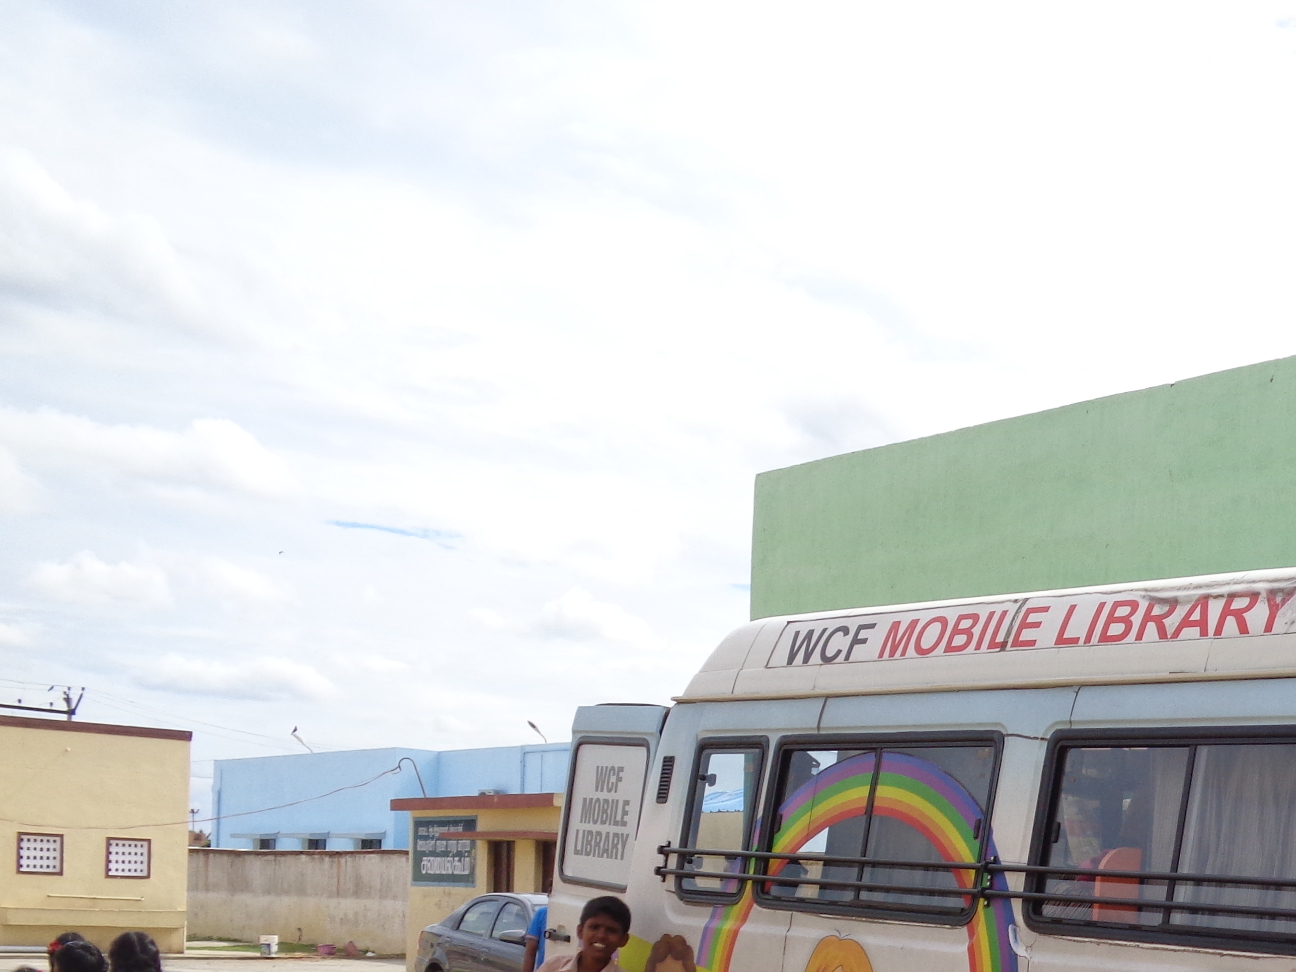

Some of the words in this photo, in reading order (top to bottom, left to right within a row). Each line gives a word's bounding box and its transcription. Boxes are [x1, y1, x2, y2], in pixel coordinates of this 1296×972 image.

[786, 623, 877, 665] WCF
[877, 606, 1050, 659] MOBILE
[595, 765, 624, 793] WCF
[580, 797, 630, 827] MOBILE
[573, 828, 629, 860] LIBRARY
